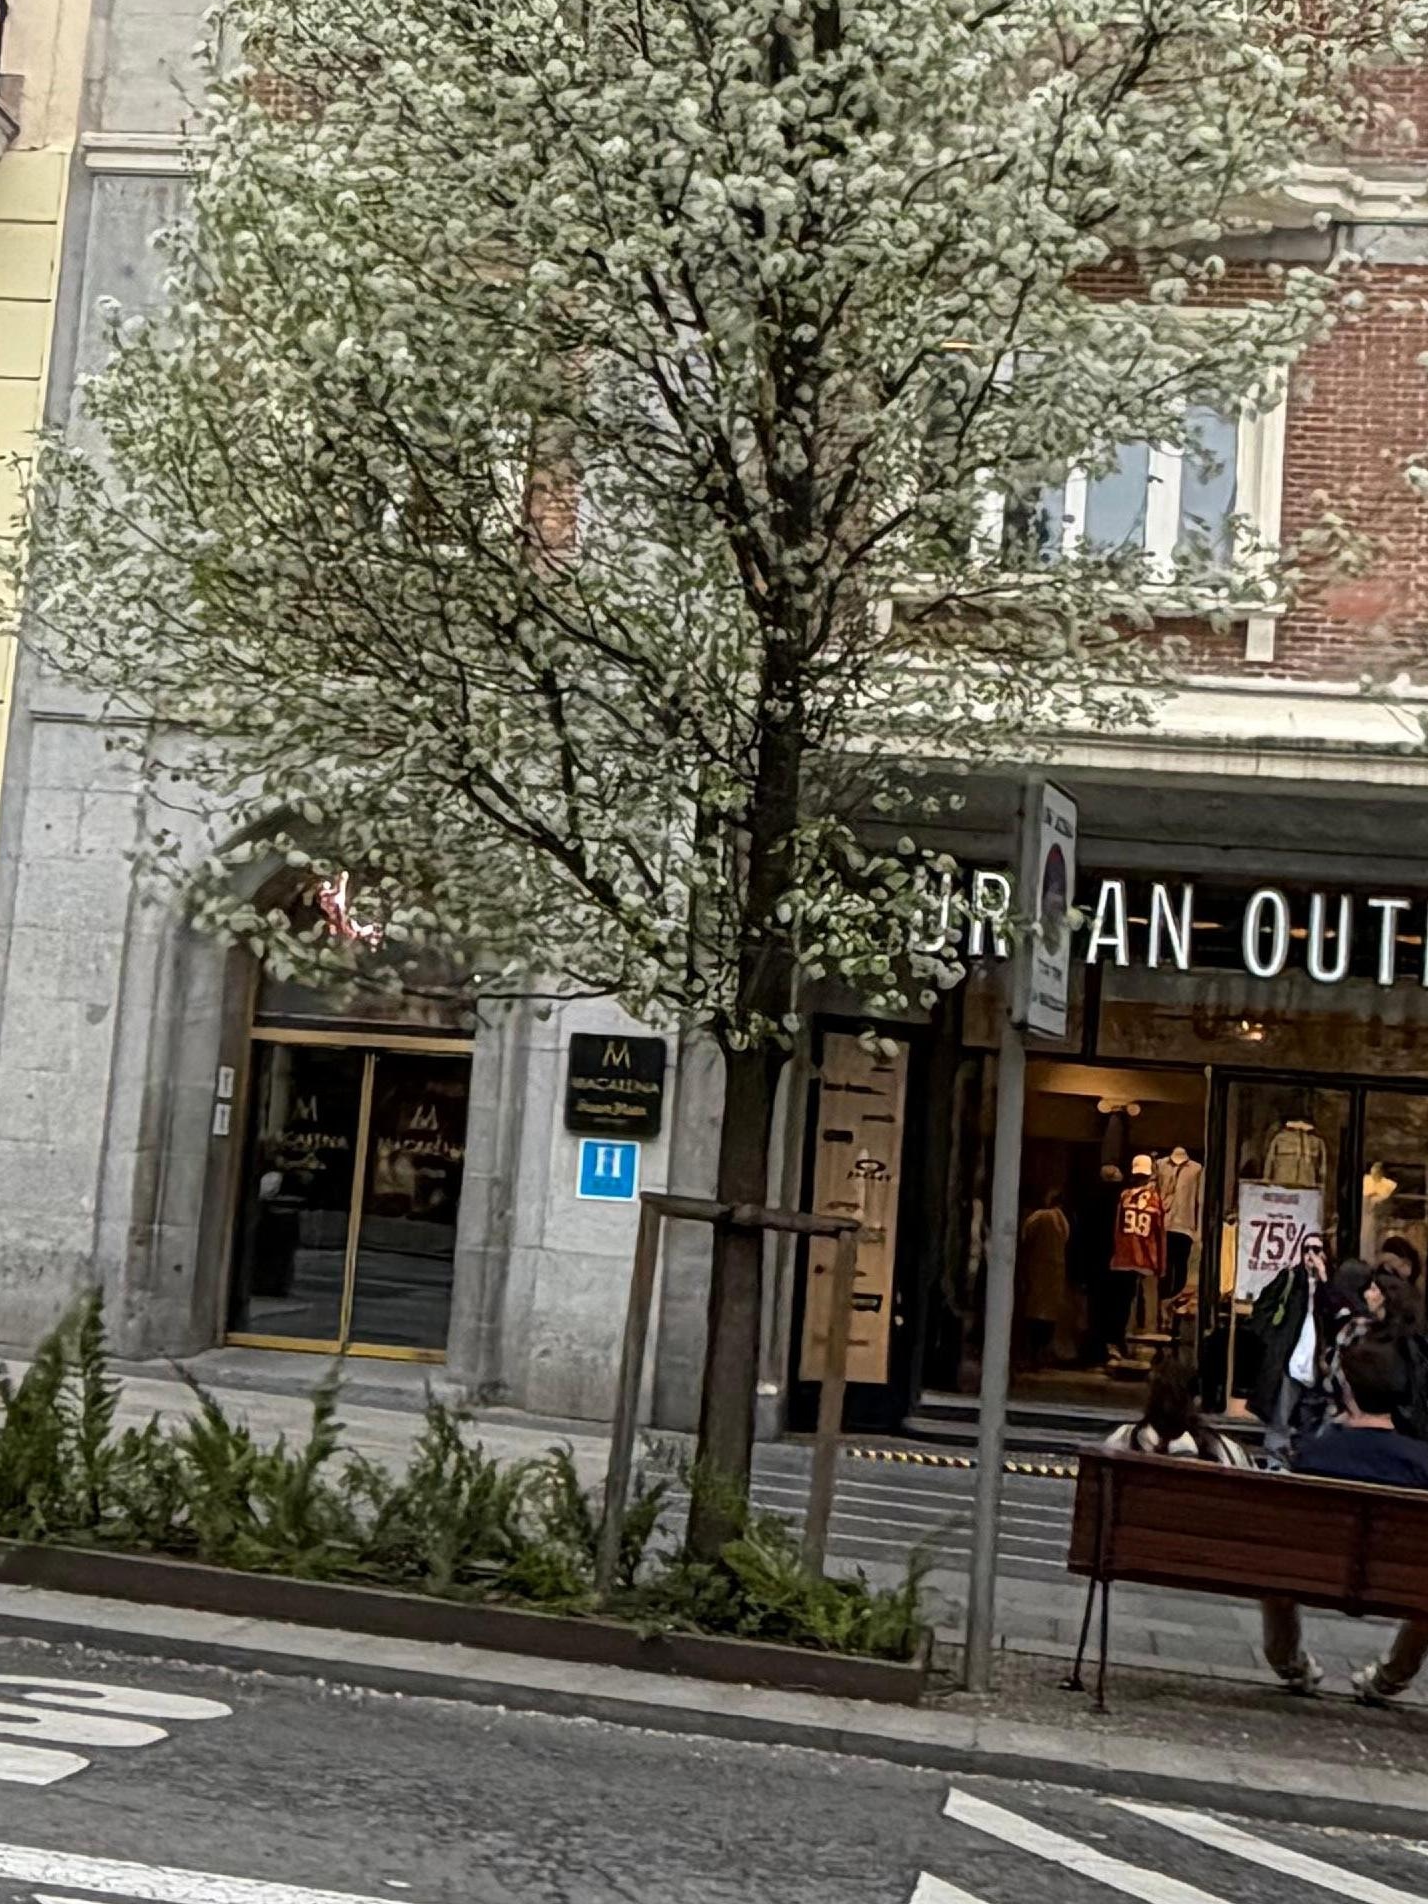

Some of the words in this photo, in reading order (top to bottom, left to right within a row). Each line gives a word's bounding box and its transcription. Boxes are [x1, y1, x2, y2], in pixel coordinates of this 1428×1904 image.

[912, 869, 1195, 970] URAN
[601, 1039, 631, 1071] M
[1249, 1220, 1307, 1263] 75%
